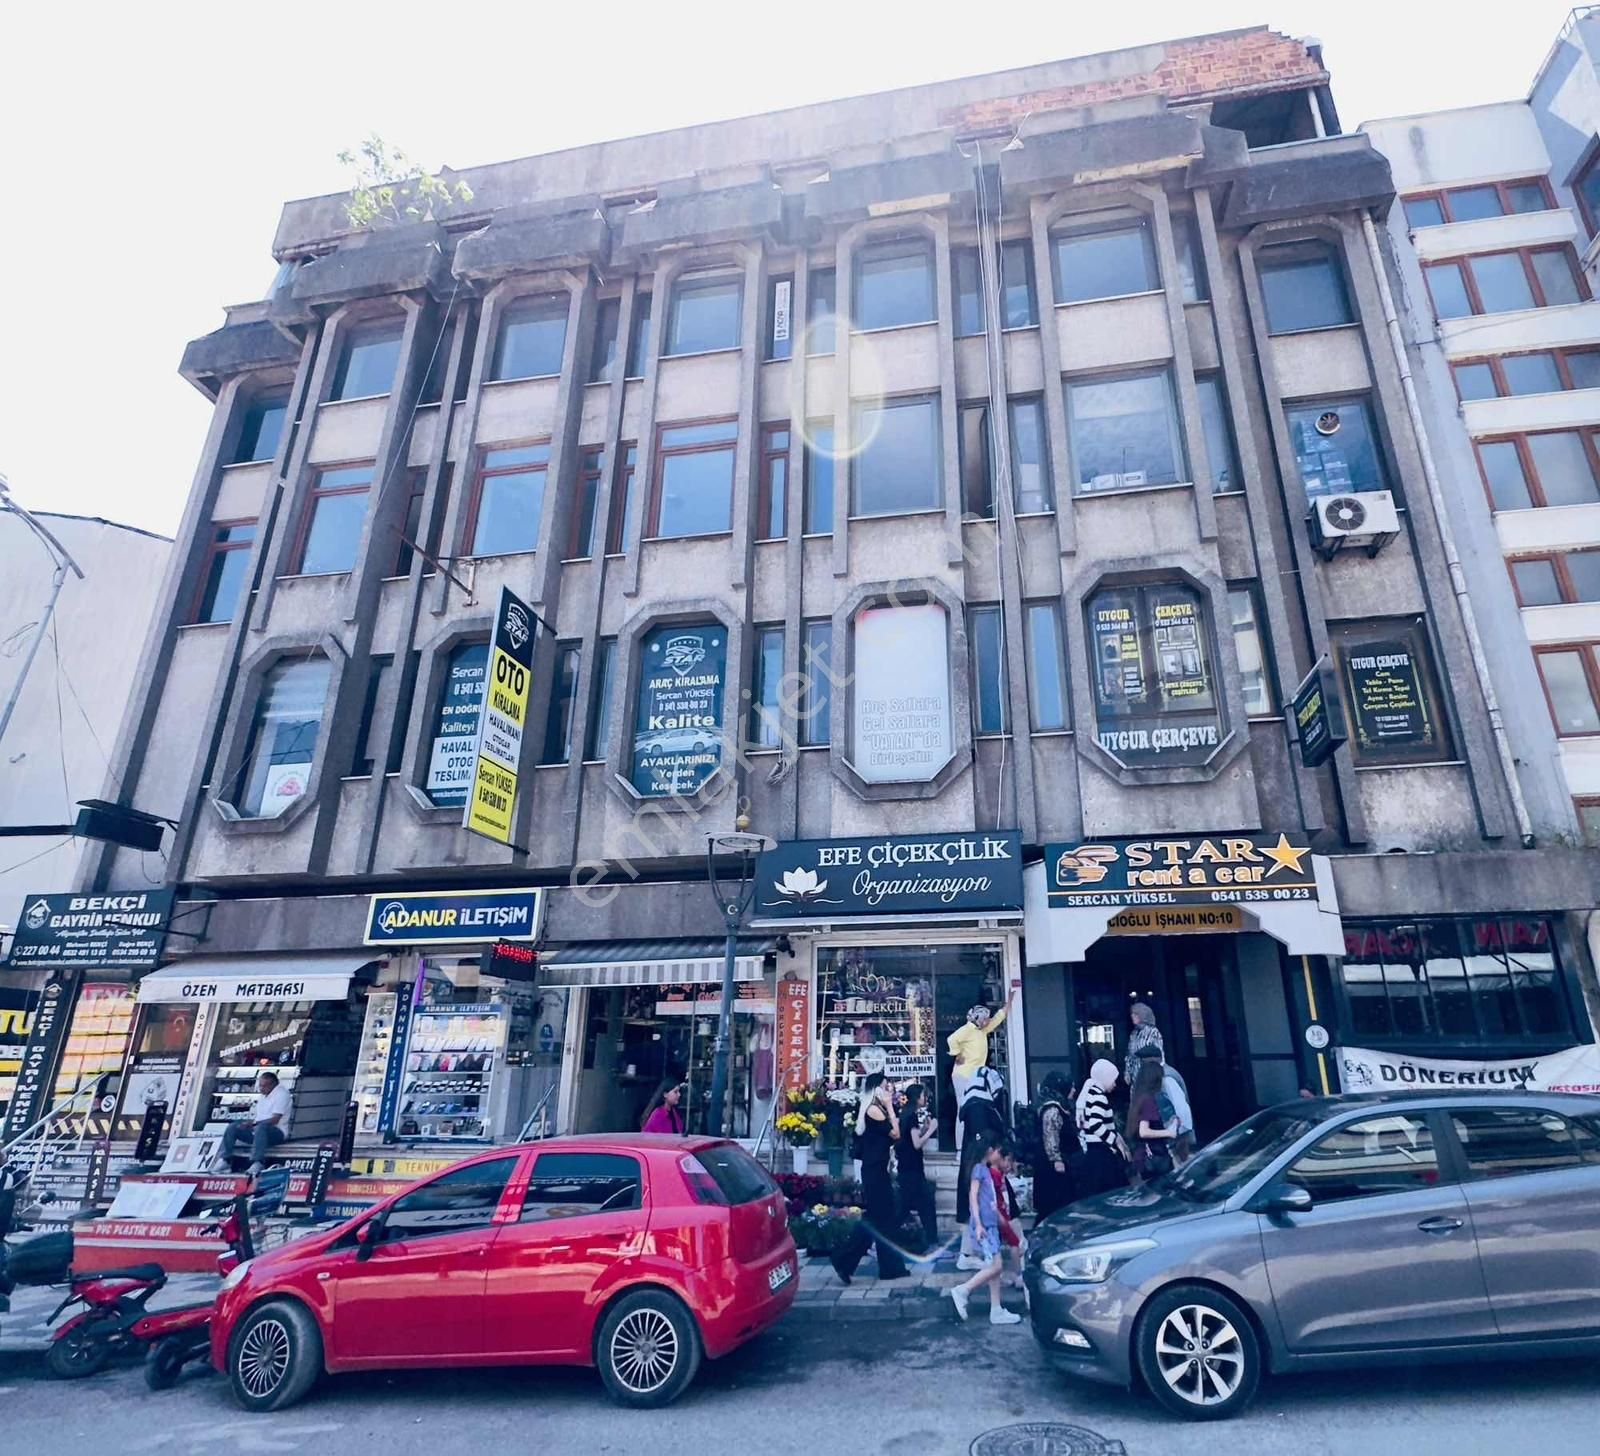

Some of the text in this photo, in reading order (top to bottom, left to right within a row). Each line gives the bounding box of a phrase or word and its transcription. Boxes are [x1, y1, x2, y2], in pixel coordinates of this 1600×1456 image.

[1098, 604, 1192, 621] UYGUR ÇERÇEVE
[505, 620, 529, 643] STAR
[663, 653, 706, 666] STAR
[1351, 653, 1409, 670] UYGUR ÇERÇEVE
[451, 667, 483, 678] Sercan
[496, 654, 524, 697] OTO
[649, 678, 673, 689] ARAÇ
[656, 688, 715, 701] Sercan YÜKSEL
[442, 706, 454, 715] EN
[441, 721, 475, 735] Kaliteyi
[648, 714, 716, 731] Kalite
[1100, 725, 1218, 752] UYGUR ÇERÇEVE
[640, 754, 716, 768] AYAKLARINIZI
[659, 768, 695, 778] Yerden
[818, 837, 1012, 868] EFE ÇİÇEKÇİLİK
[1124, 838, 1264, 867] STAR
[1127, 865, 1265, 886] rent a car
[852, 869, 992, 905] Organizasyon
[69, 894, 147, 912] BEKÇİ
[1067, 887, 1310, 906] SERCAN YÜKSEL 0541 538 00 23
[384, 906, 528, 928] ADANUR İLETİŞİM
[1155, 911, 1195, 929] İŞHANI
[1199, 911, 1233, 925] NO:10
[22, 945, 60, 956] 227 00 44
[182, 981, 304, 997] ÖZEN MATBAASI
[789, 983, 808, 996] EFE
[38, 1000, 57, 1037] BEKÇİ
[395, 983, 411, 1045] ADANUR
[202, 1179, 236, 1191] BROŞÜR
[325, 1207, 341, 1217] HER
[149, 1226, 172, 1236] KART
